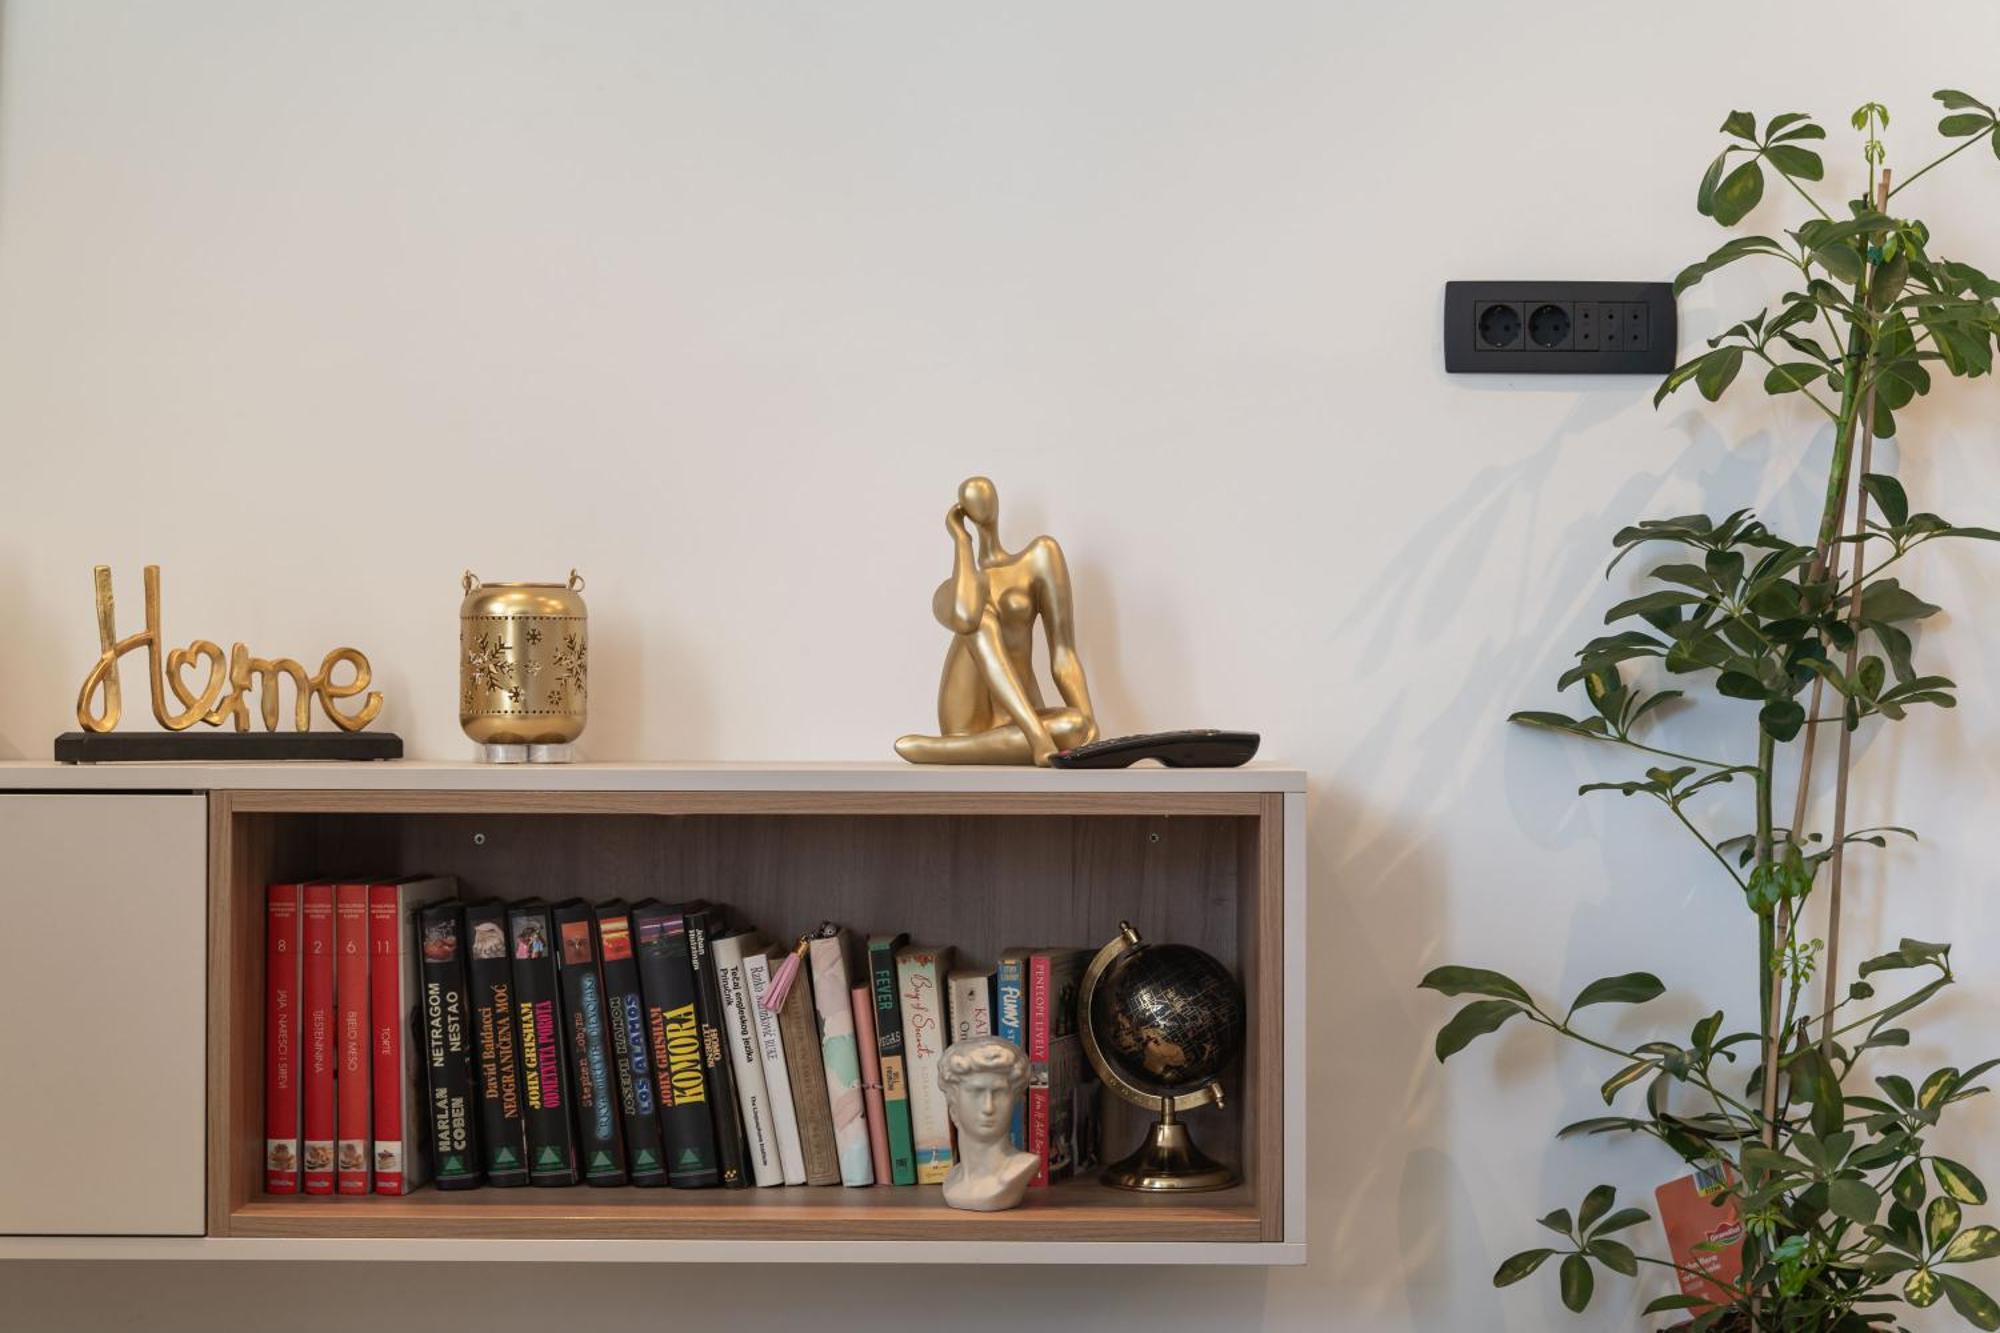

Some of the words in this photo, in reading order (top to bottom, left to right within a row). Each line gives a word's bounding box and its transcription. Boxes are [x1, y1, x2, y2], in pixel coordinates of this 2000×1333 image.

[77, 564, 384, 733] Home
[278, 940, 286, 952] 8
[314, 941, 322, 954] 2
[346, 941, 356, 954] 6
[377, 941, 389, 954] 11
[696, 929, 704, 955] Johan
[490, 983, 509, 1013] MOĆ
[720, 967, 734, 1006] Priručnik
[751, 966, 764, 992] Ranko
[875, 970, 892, 1010] FEVER
[1035, 964, 1045, 1018] PENELOPE
[347, 1011, 358, 1038] BIJELO
[428, 983, 444, 1067] NETRAGOM
[446, 991, 461, 1052] NESTAO
[536, 1000, 555, 1044] POROTA
[609, 996, 627, 1054] KANON
[731, 966, 739, 990] Tečaj
[735, 992, 749, 1036] engleskog
[742, 1036, 753, 1063] jezika
[1001, 986, 1021, 1028] FUNNY
[313, 1010, 324, 1073] TJESTENINA
[381, 1027, 391, 1055] TORTE
[478, 1006, 496, 1060] Baldacci
[520, 1002, 538, 1069] GRISHAM
[625, 994, 647, 1072] ALAMOS
[650, 1007, 668, 1069] GRISHAM
[663, 1003, 705, 1106] KOMORA
[702, 1023, 715, 1068] LUDENS
[710, 1028, 721, 1061] HOMO
[1035, 1020, 1045, 1057] LIVELY
[348, 1041, 358, 1071] MESO
[496, 1017, 518, 1119] NEOGRANIČENA
[483, 1063, 498, 1099] David
[526, 1071, 541, 1110] JOHN
[578, 1059, 593, 1107] Stephen
[619, 1059, 635, 1115] JOSEPH
[636, 1078, 652, 1114] LOS
[658, 1072, 672, 1107] JOHN
[435, 1087, 451, 1152] HARLAN
[452, 1096, 466, 1150] COBEN
